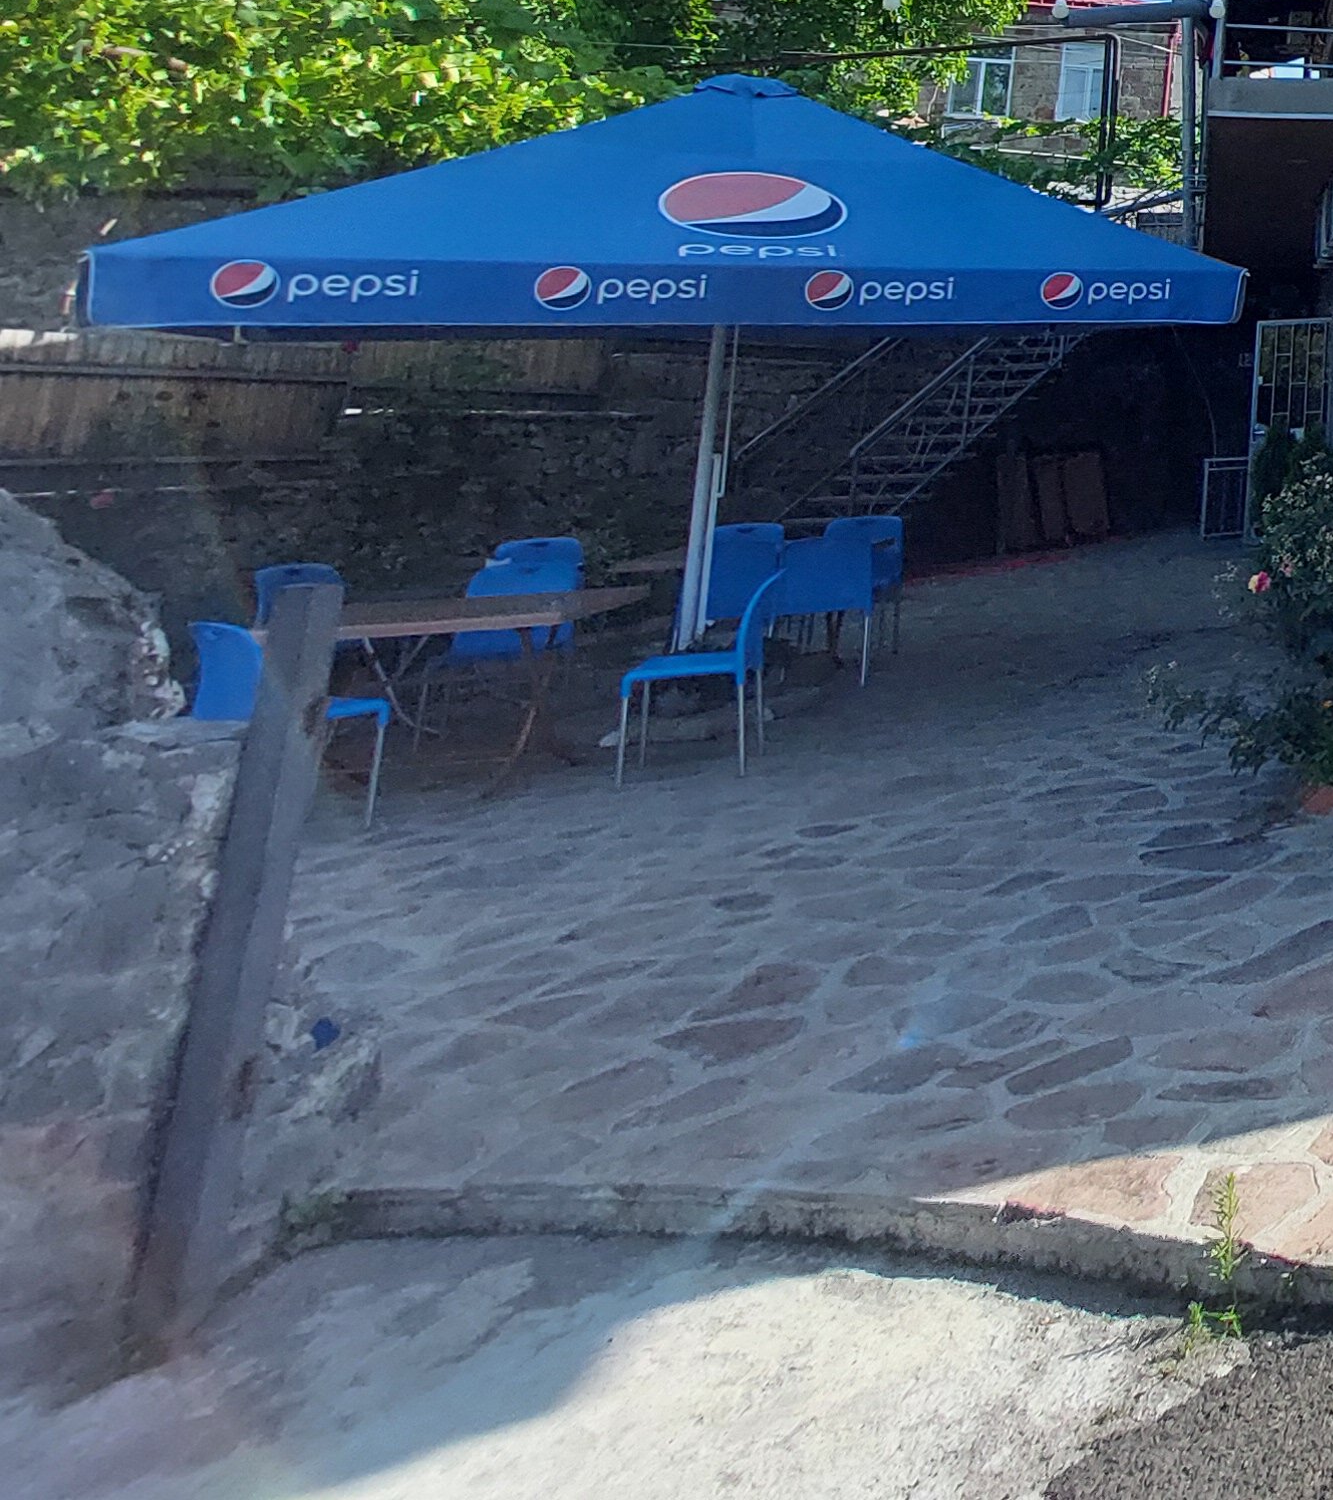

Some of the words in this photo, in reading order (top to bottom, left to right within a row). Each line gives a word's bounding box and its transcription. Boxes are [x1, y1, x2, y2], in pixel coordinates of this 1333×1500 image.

[678, 243, 838, 259] pepsi
[287, 269, 420, 304] pepsi
[596, 274, 708, 305] pepsi
[858, 277, 955, 306] pepsi
[1087, 278, 1172, 305] pepsi
